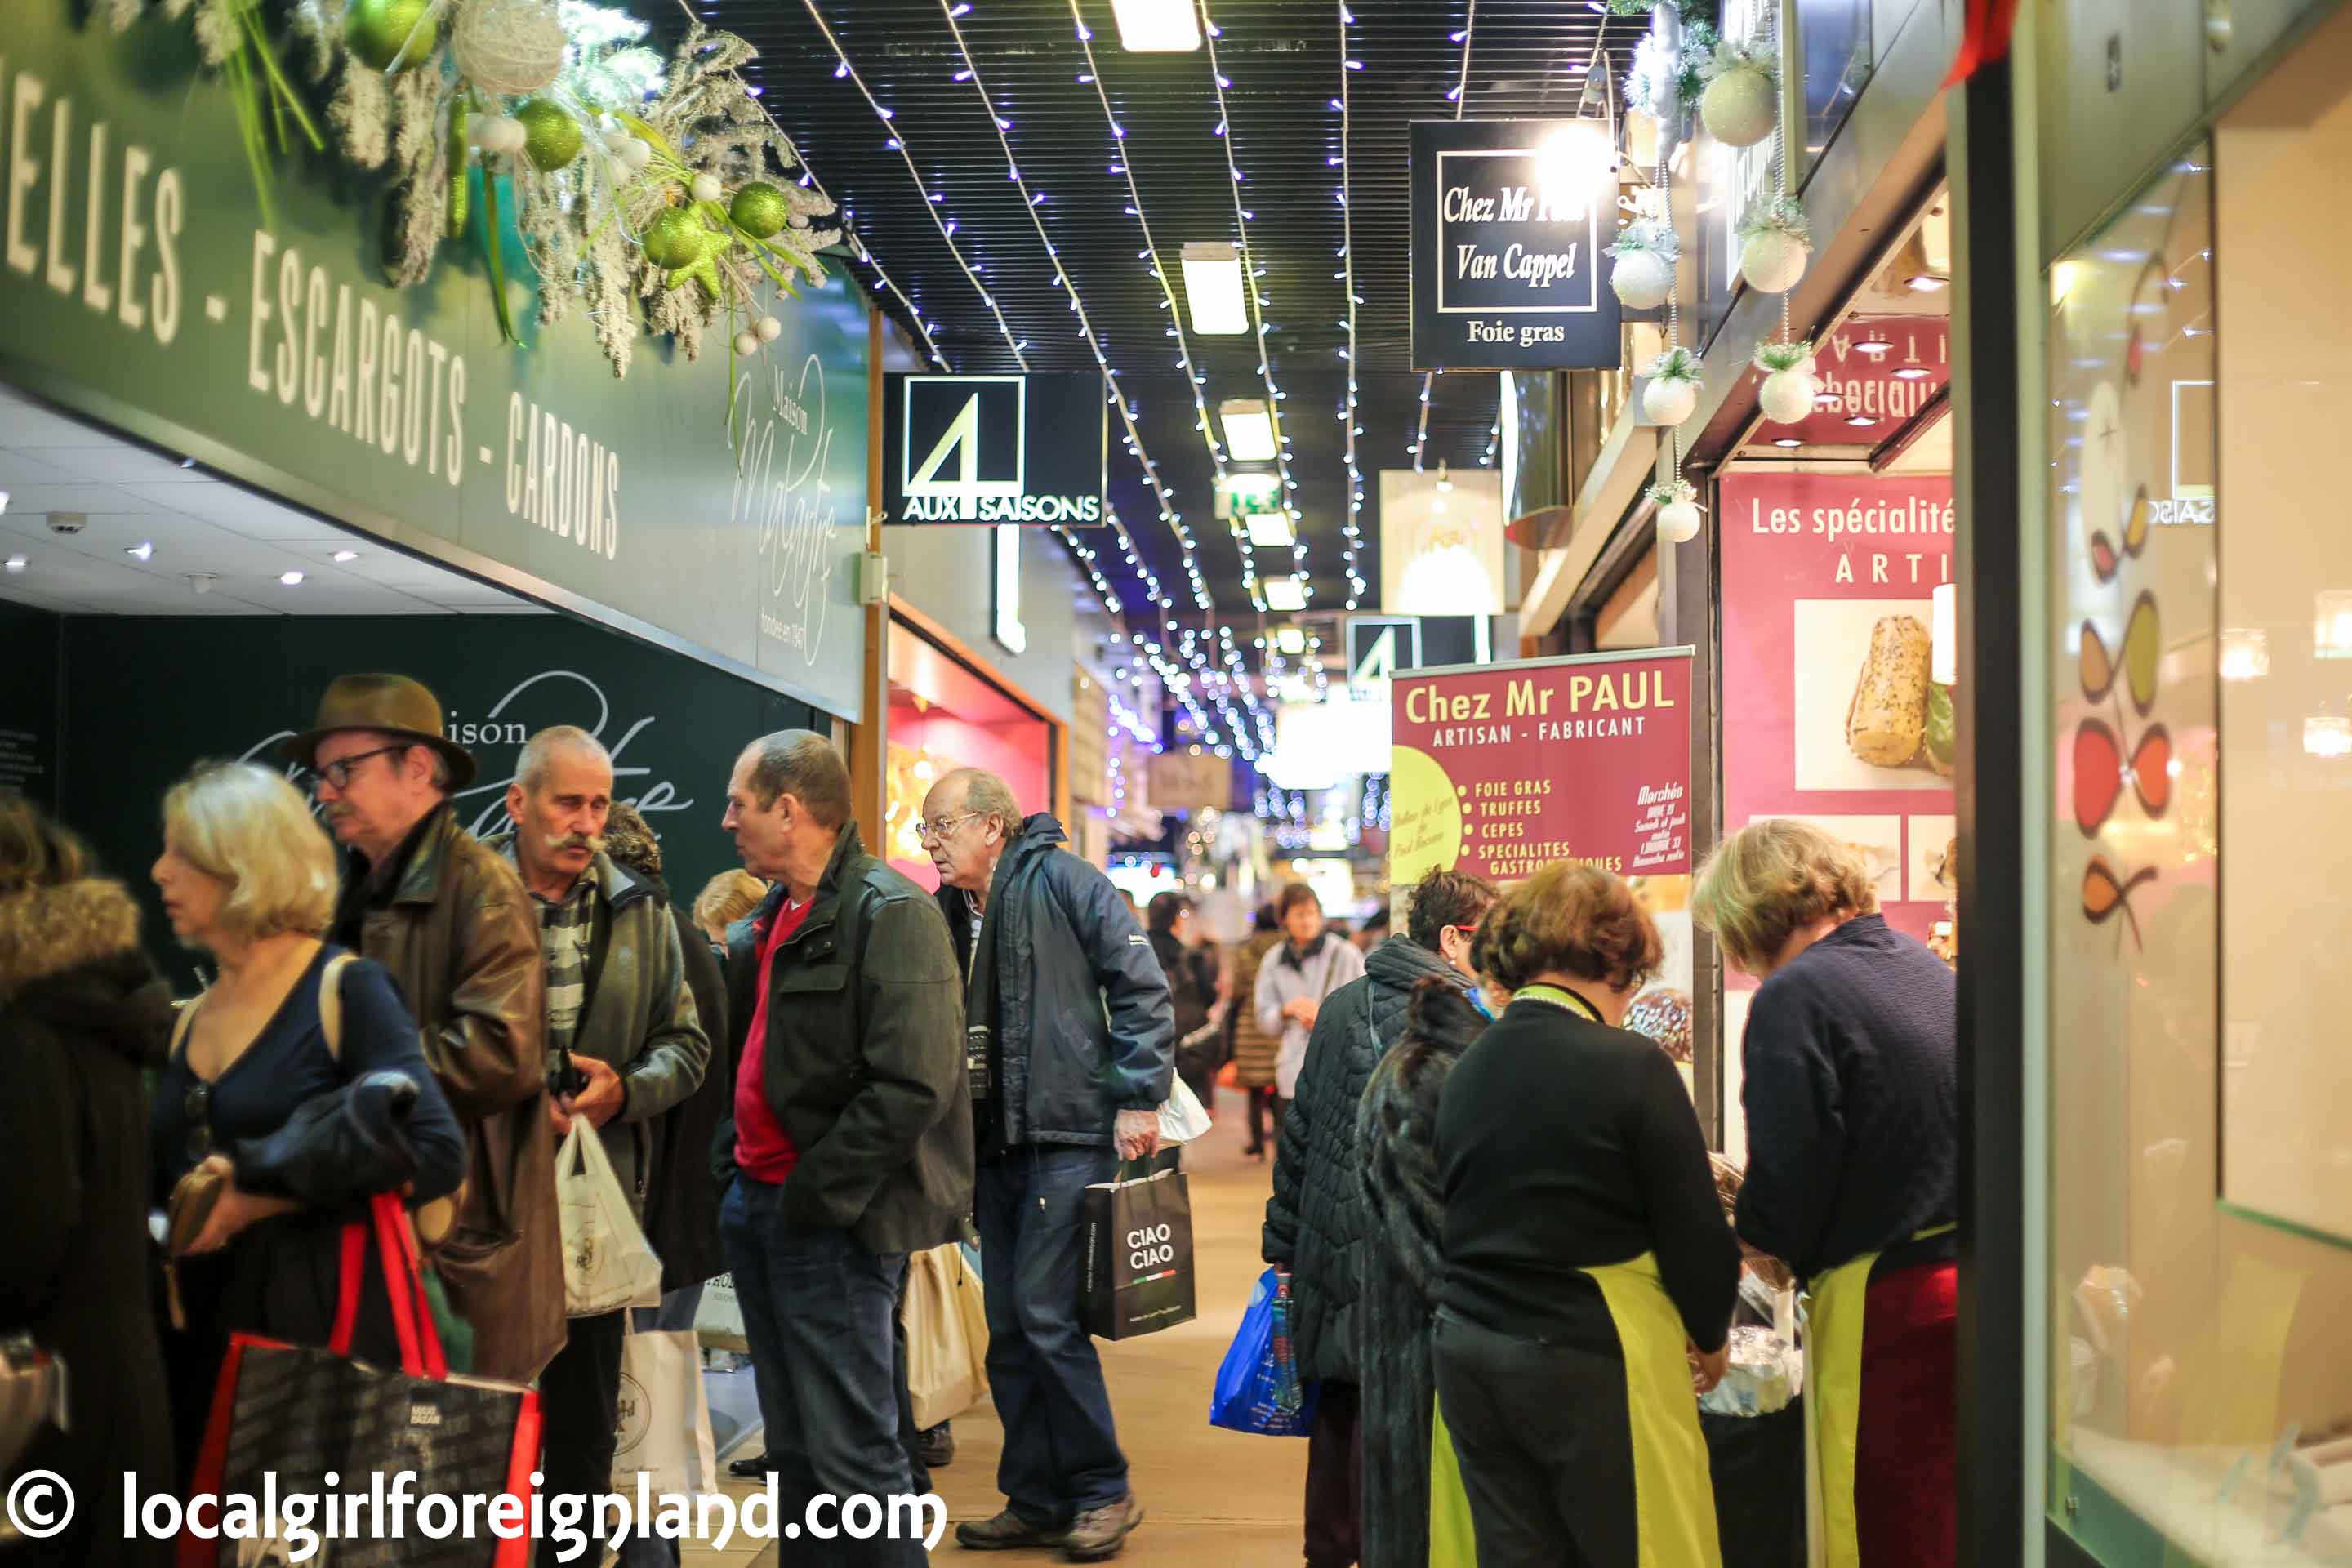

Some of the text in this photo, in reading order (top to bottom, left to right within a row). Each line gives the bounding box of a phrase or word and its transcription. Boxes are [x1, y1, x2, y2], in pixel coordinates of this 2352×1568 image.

[1444, 186, 1494, 222] Chez
[1498, 187, 1535, 222] Mr
[1457, 242, 1577, 287] Van Cappel
[0, 61, 183, 345] ELLES
[248, 229, 467, 487] ESCARGOTS
[506, 391, 619, 560] CARDONS
[1467, 320, 1565, 347] Foie gras
[906, 392, 979, 520] 4
[902, 495, 1100, 521] AUX SAISONS
[1753, 497, 1802, 533] Les
[1835, 552, 1949, 583] ARTI
[1405, 670, 1674, 724] Chez Mr PAUL
[450, 710, 527, 744] ison
[1433, 725, 1511, 747] ARTISAN
[1539, 716, 1645, 741] FABRICANT
[1475, 780, 1551, 798] FOIE GRAS
[1480, 800, 1541, 817] TRUFFES
[1482, 822, 1524, 839] CEPES
[1478, 842, 1570, 859] SPECIALITES
[1490, 857, 1622, 876] GASTROIQUES
[1127, 1223, 1171, 1249] CIAO
[1129, 1244, 1174, 1269] CIAO
